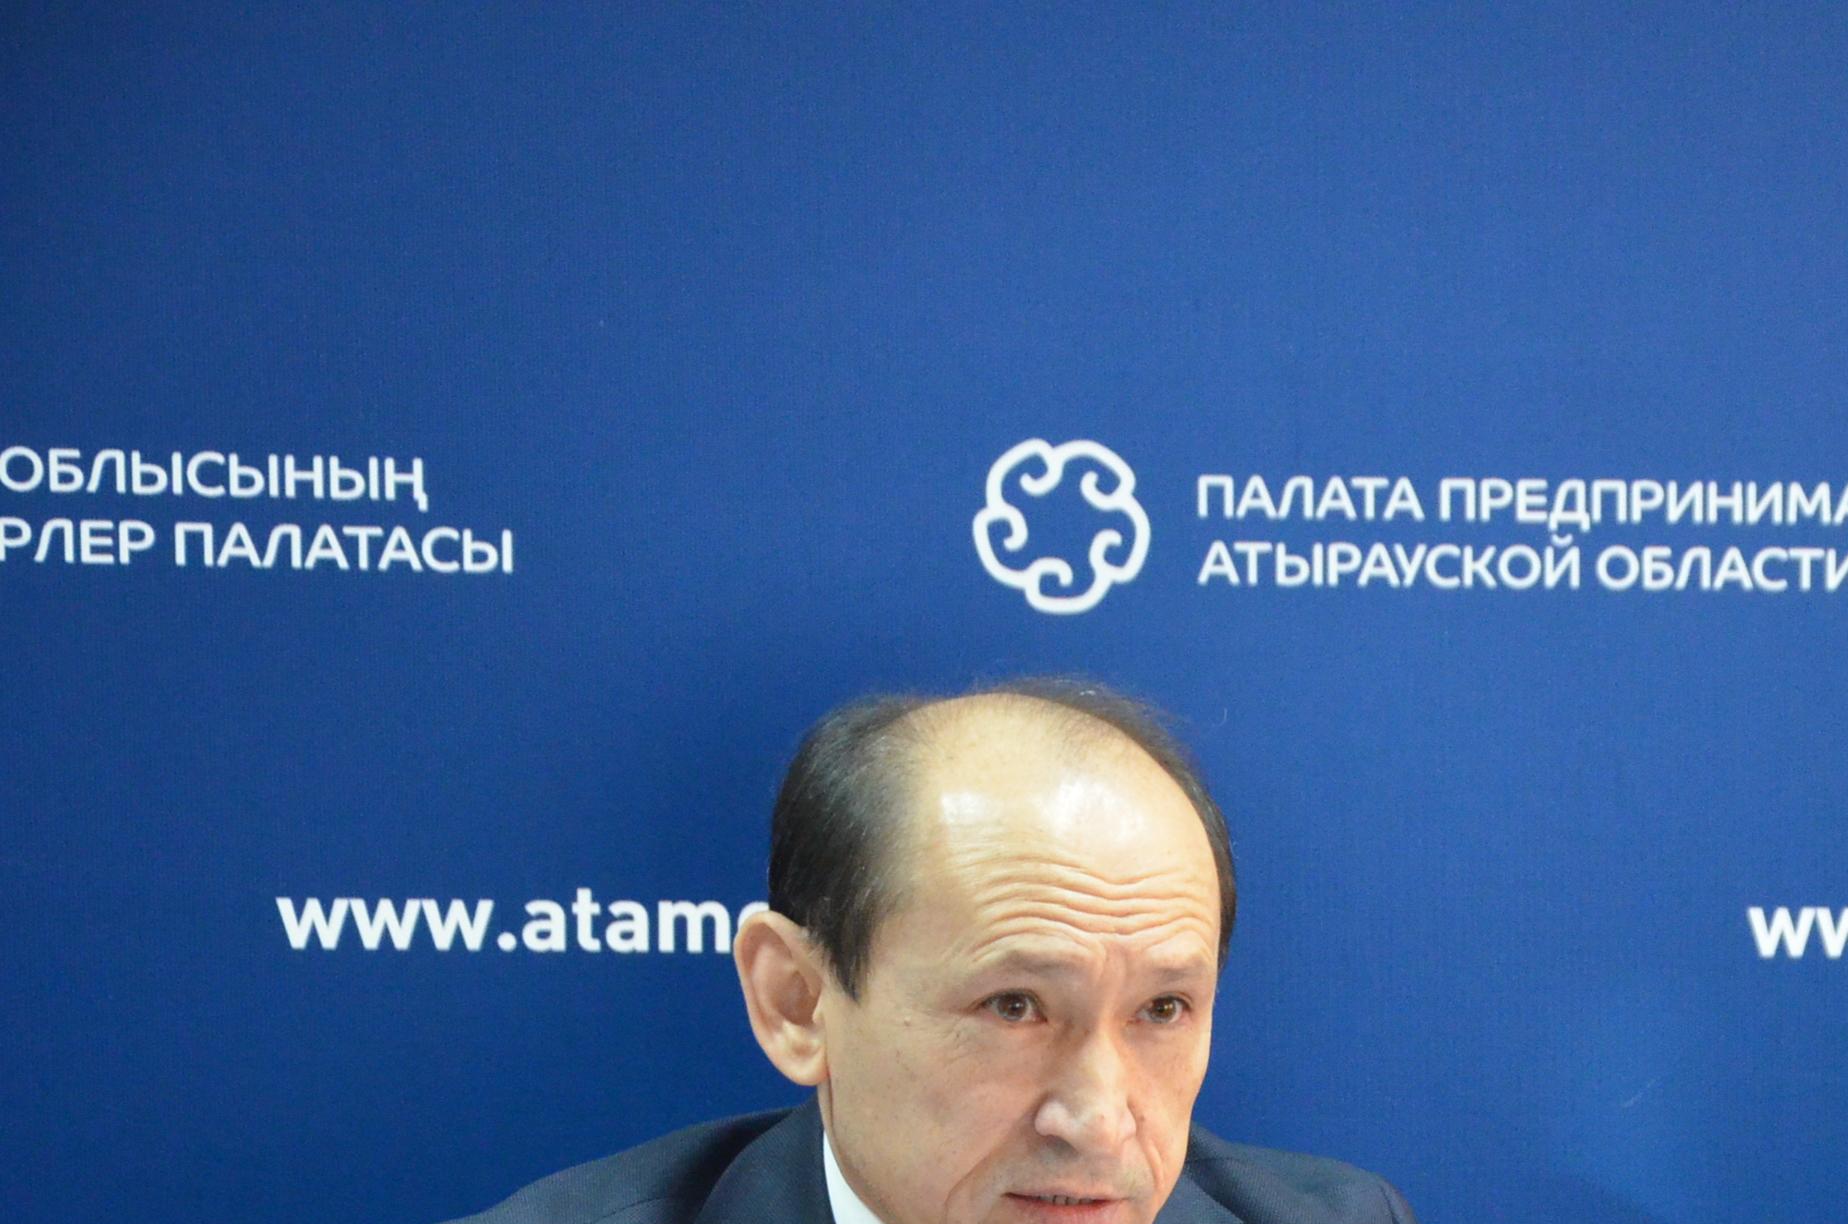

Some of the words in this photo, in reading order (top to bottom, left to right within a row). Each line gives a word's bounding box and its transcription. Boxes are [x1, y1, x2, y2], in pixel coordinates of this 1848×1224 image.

[0, 446, 429, 512] ОБЛЫСЫНЫҢ
[1197, 474, 1423, 523] ПАЛАТА
[174, 520, 514, 574] ПАЛАТАСЫ
[1197, 533, 1581, 592] АТЫРАУСКОЙ
[275, 888, 769, 956] www.atam
